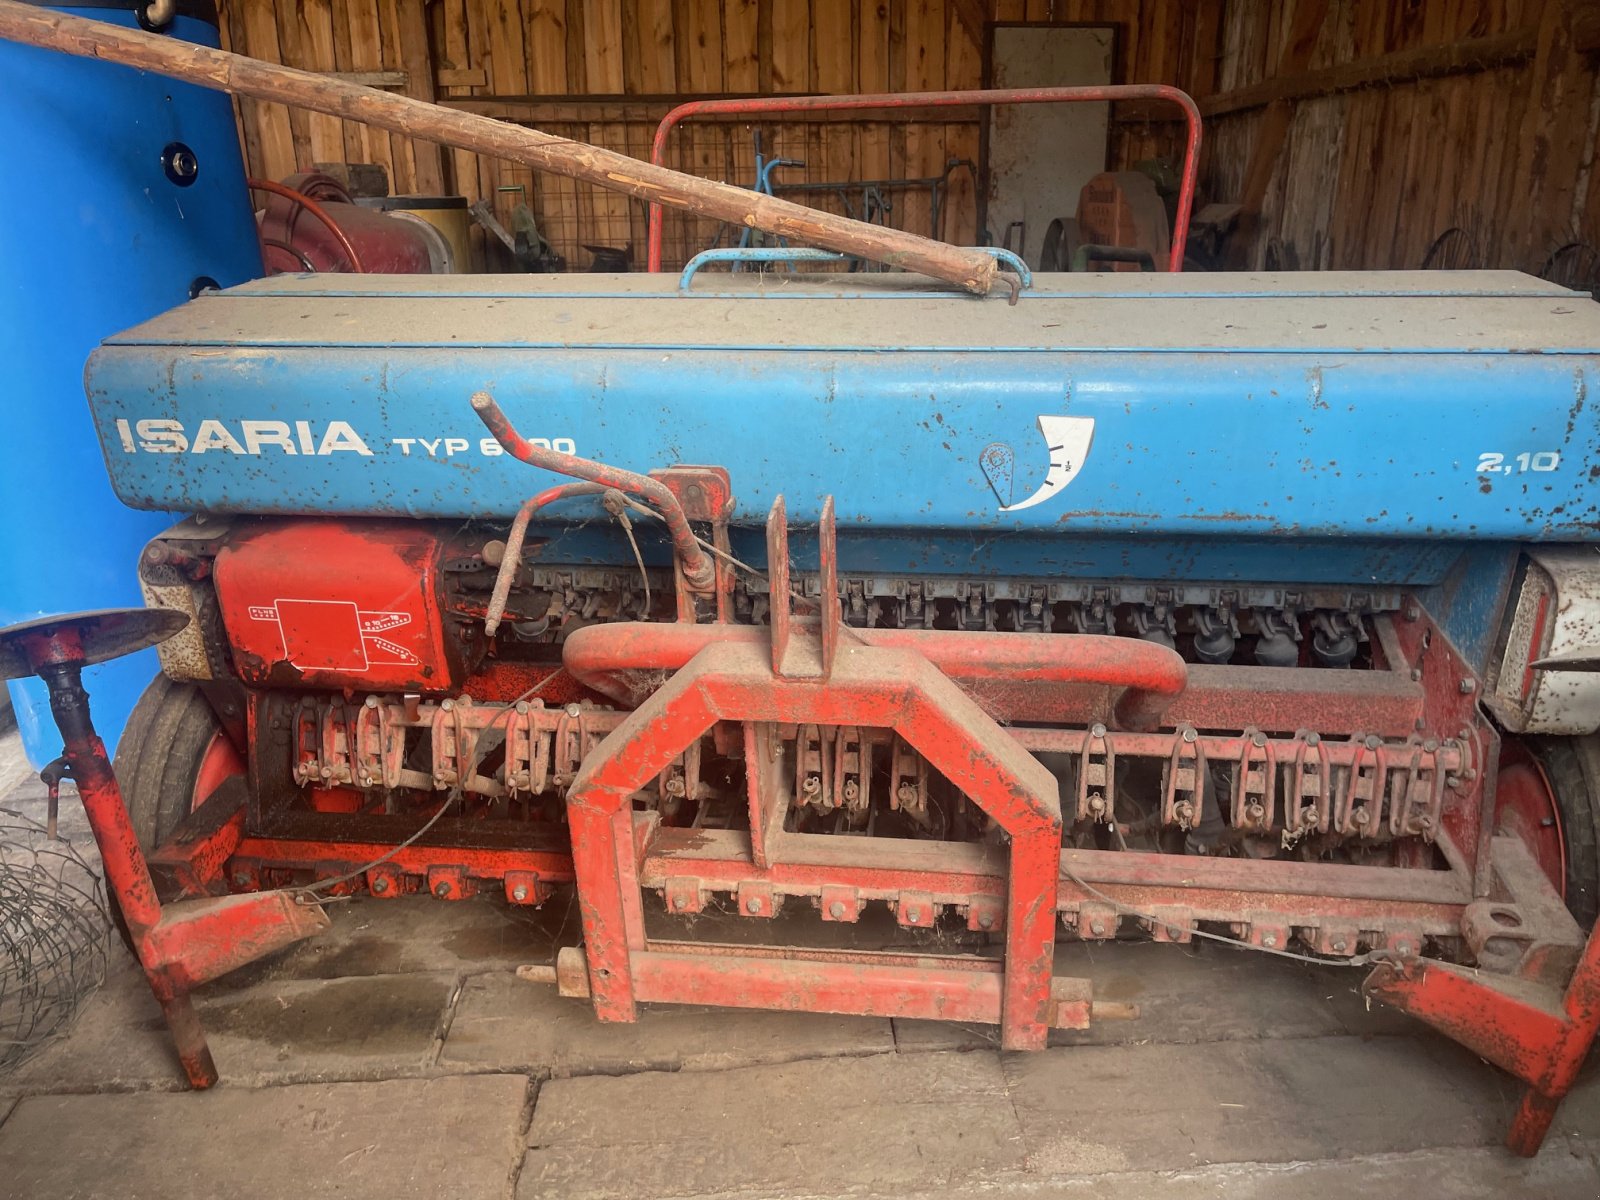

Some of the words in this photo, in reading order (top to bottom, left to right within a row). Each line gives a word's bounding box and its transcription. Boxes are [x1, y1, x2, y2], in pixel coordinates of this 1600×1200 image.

[116, 419, 375, 456] ISARIA
[392, 438, 470, 456] TYP
[480, 438, 576, 456] 600
[1476, 452, 1560, 475] 2,10
